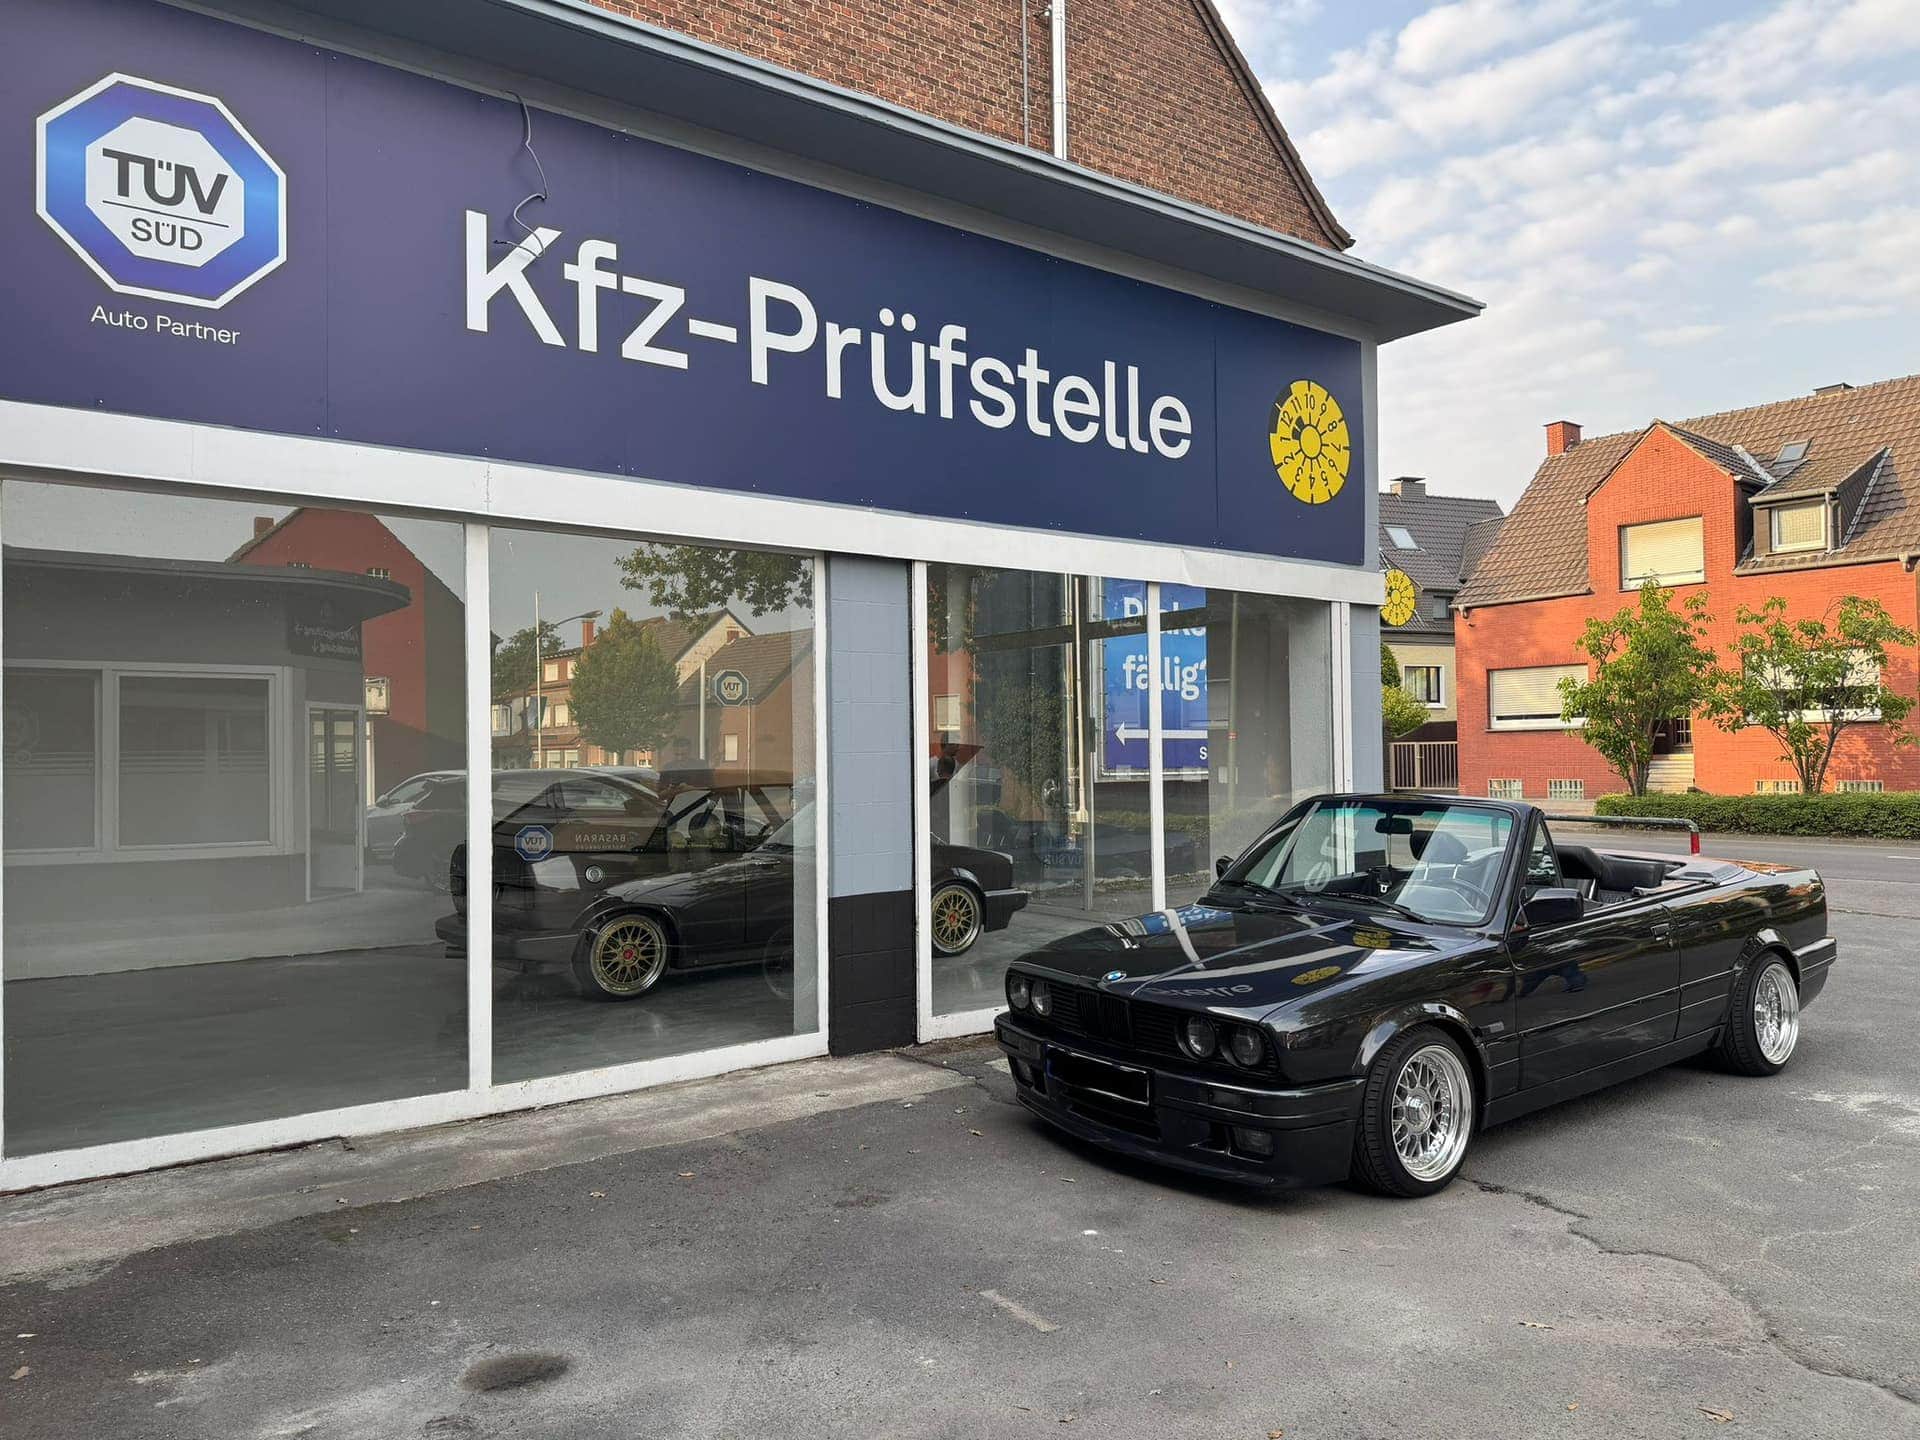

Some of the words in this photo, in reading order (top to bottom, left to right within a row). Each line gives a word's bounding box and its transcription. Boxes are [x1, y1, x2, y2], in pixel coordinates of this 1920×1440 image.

[102, 147, 229, 215] TÜV
[131, 217, 203, 251] SÜD
[91, 304, 148, 330] Auto
[156, 314, 241, 345] Partner
[465, 209, 1192, 459] Kfz-Prüfstelle
[1291, 396, 1302, 413] 11
[1304, 393, 1315, 410] 10
[1319, 402, 1327, 416] 9
[1281, 410, 1293, 427] 12
[1327, 420, 1337, 432] 8
[1331, 442, 1341, 452] 7
[1283, 452, 1295, 465] 2
[1328, 458, 1338, 471] 6
[1295, 466, 1303, 482] 3
[1309, 473, 1315, 490] 4
[1320, 470, 1329, 487] 5
